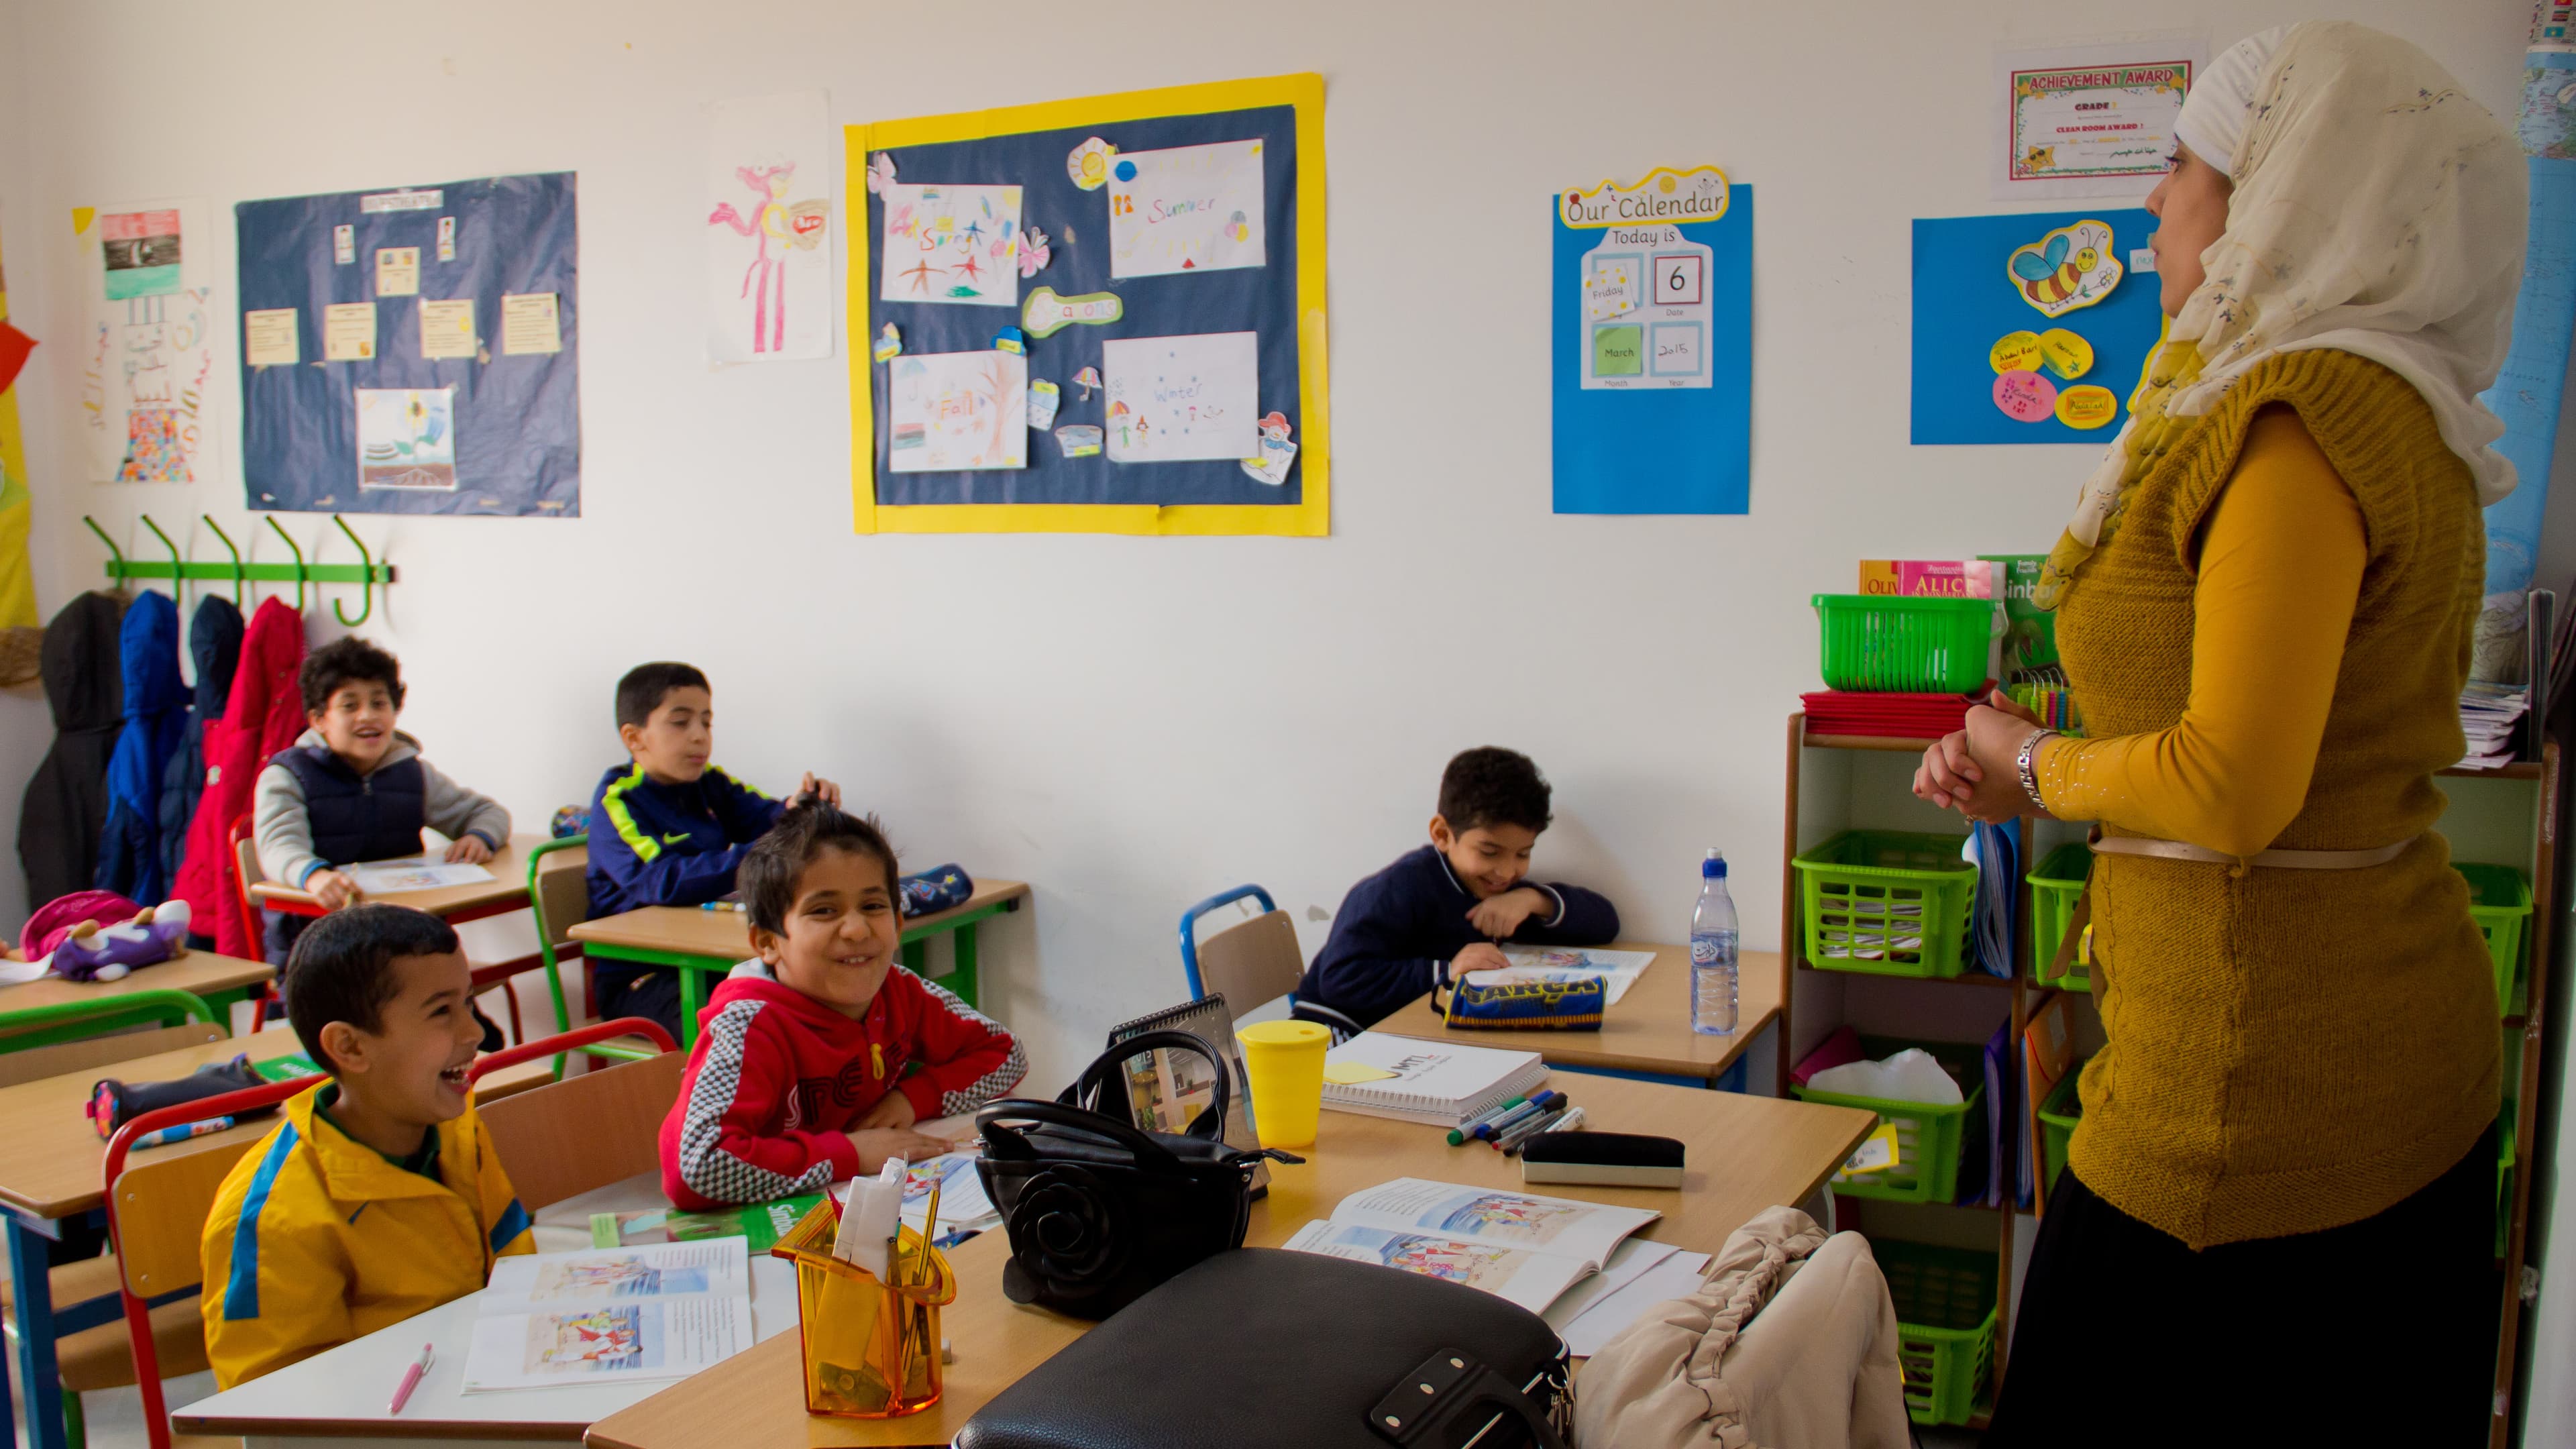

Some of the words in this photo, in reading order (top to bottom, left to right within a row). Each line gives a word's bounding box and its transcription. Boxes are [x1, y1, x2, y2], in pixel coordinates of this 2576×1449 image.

[2029, 72, 2121, 90] ACHIEVEMENT
[2125, 69, 2174, 85] AWARD
[2075, 102, 2110, 111] GRADE
[2056, 125, 2080, 133] CLEAN
[2082, 125, 2106, 133] ROOM
[2108, 123, 2138, 132] AWARD
[1147, 195, 1216, 224] Summer
[1568, 201, 1609, 222] Our
[1619, 191, 1724, 219] Calendar
[1612, 229, 1658, 247] Today
[1664, 229, 1676, 244] is
[2136, 256, 2153, 264] nex
[1669, 265, 1686, 291] 6
[1592, 284, 1624, 301] Friday
[1027, 293, 1115, 329] Seaons
[1666, 308, 1684, 317] Date
[1605, 346, 1635, 358] March
[1658, 343, 1688, 357] 2015
[1604, 379, 1628, 387] Month
[1668, 378, 1684, 387] Year
[1154, 382, 1202, 403] Winter
[940, 390, 975, 420] Fall
[1868, 578, 1897, 594] OLIV
[1916, 575, 1974, 592] ALICE
[1390, 1055, 1435, 1071] MTL
